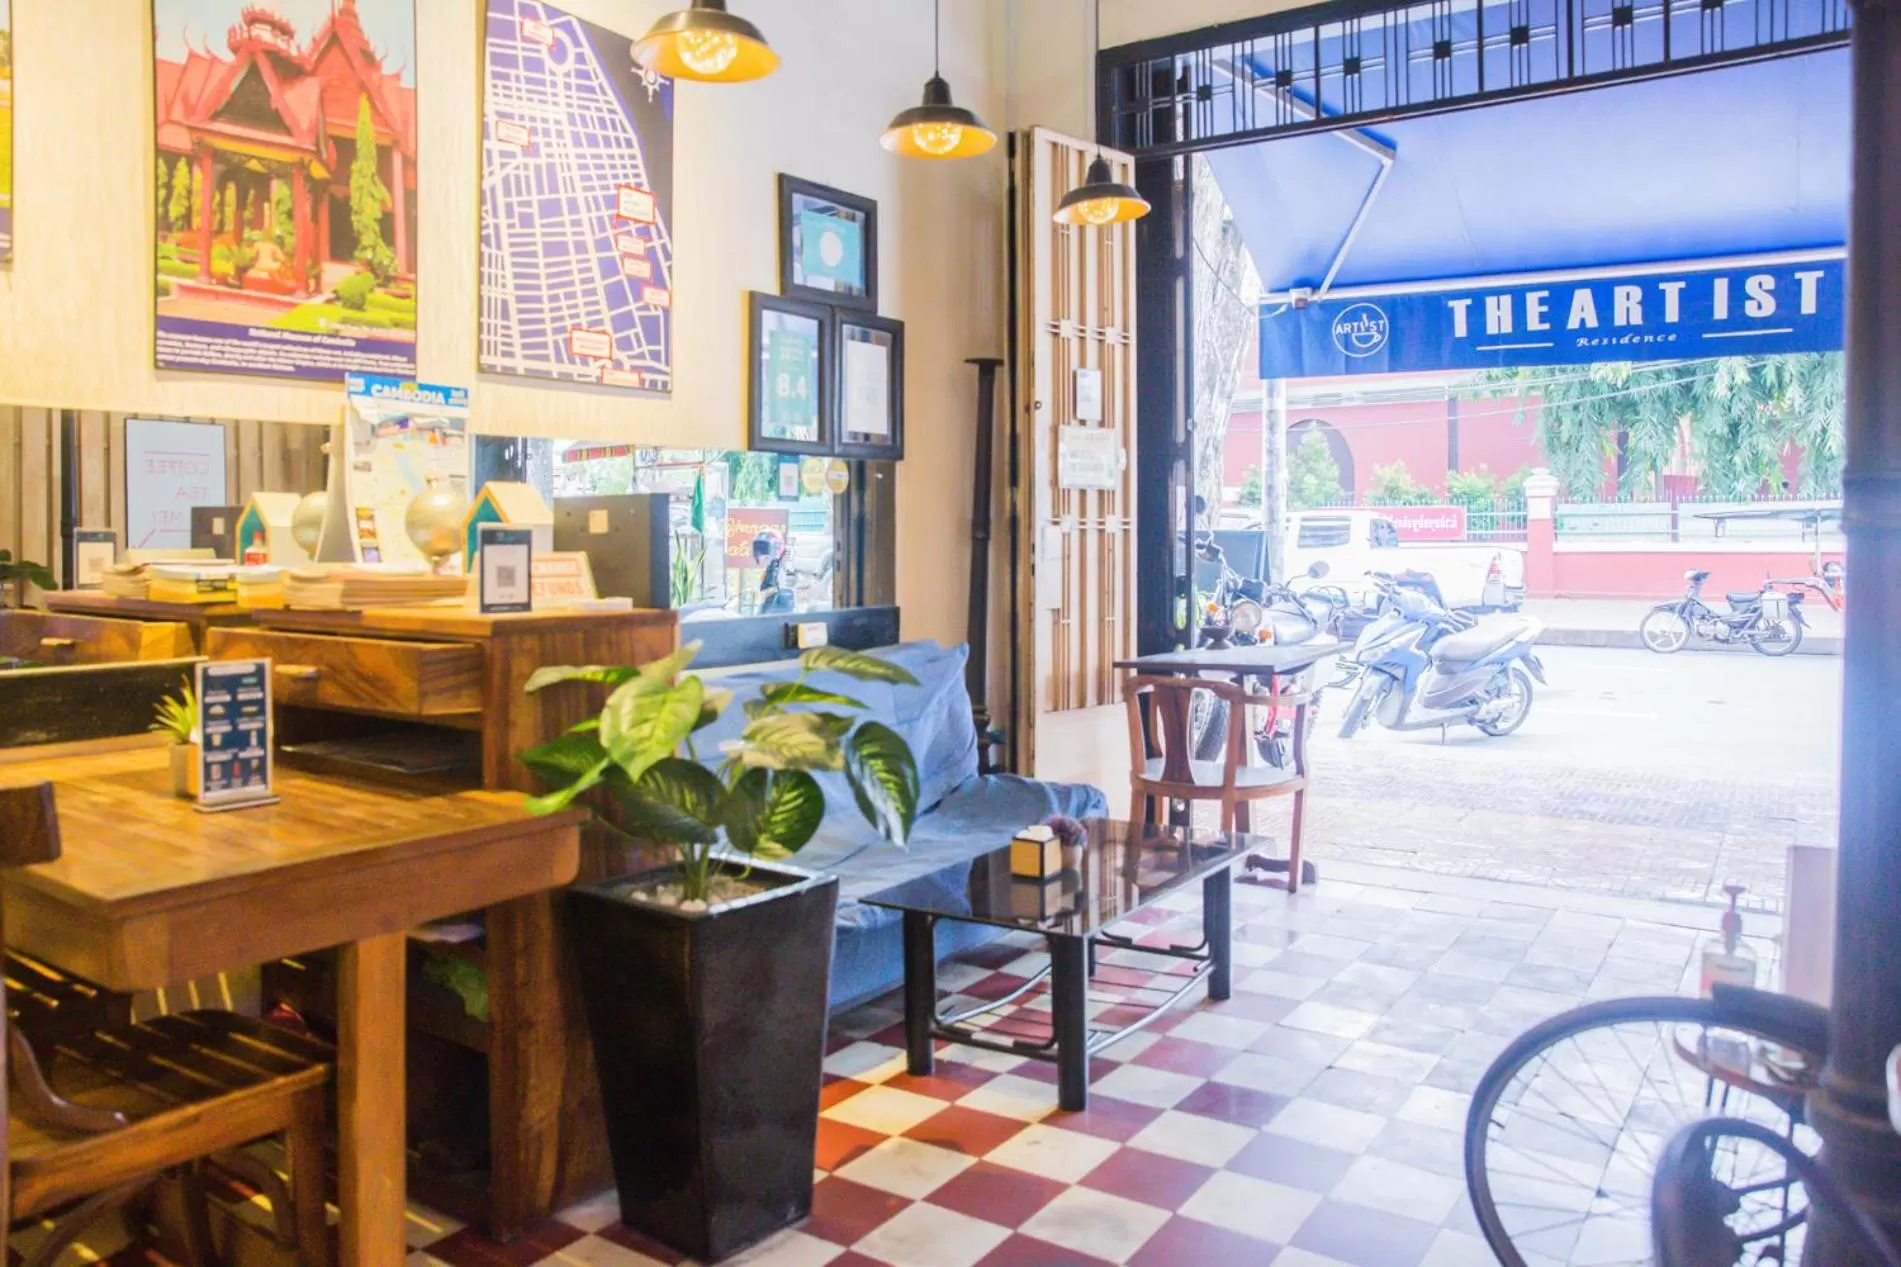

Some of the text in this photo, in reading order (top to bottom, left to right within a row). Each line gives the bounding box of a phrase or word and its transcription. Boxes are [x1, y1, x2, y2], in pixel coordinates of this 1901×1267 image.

[1448, 270, 1825, 338] THE ARTIST
[1335, 319, 1385, 335] ARTIST
[1576, 331, 1678, 347] Residence
[370, 382, 446, 405] CAMBODIA
